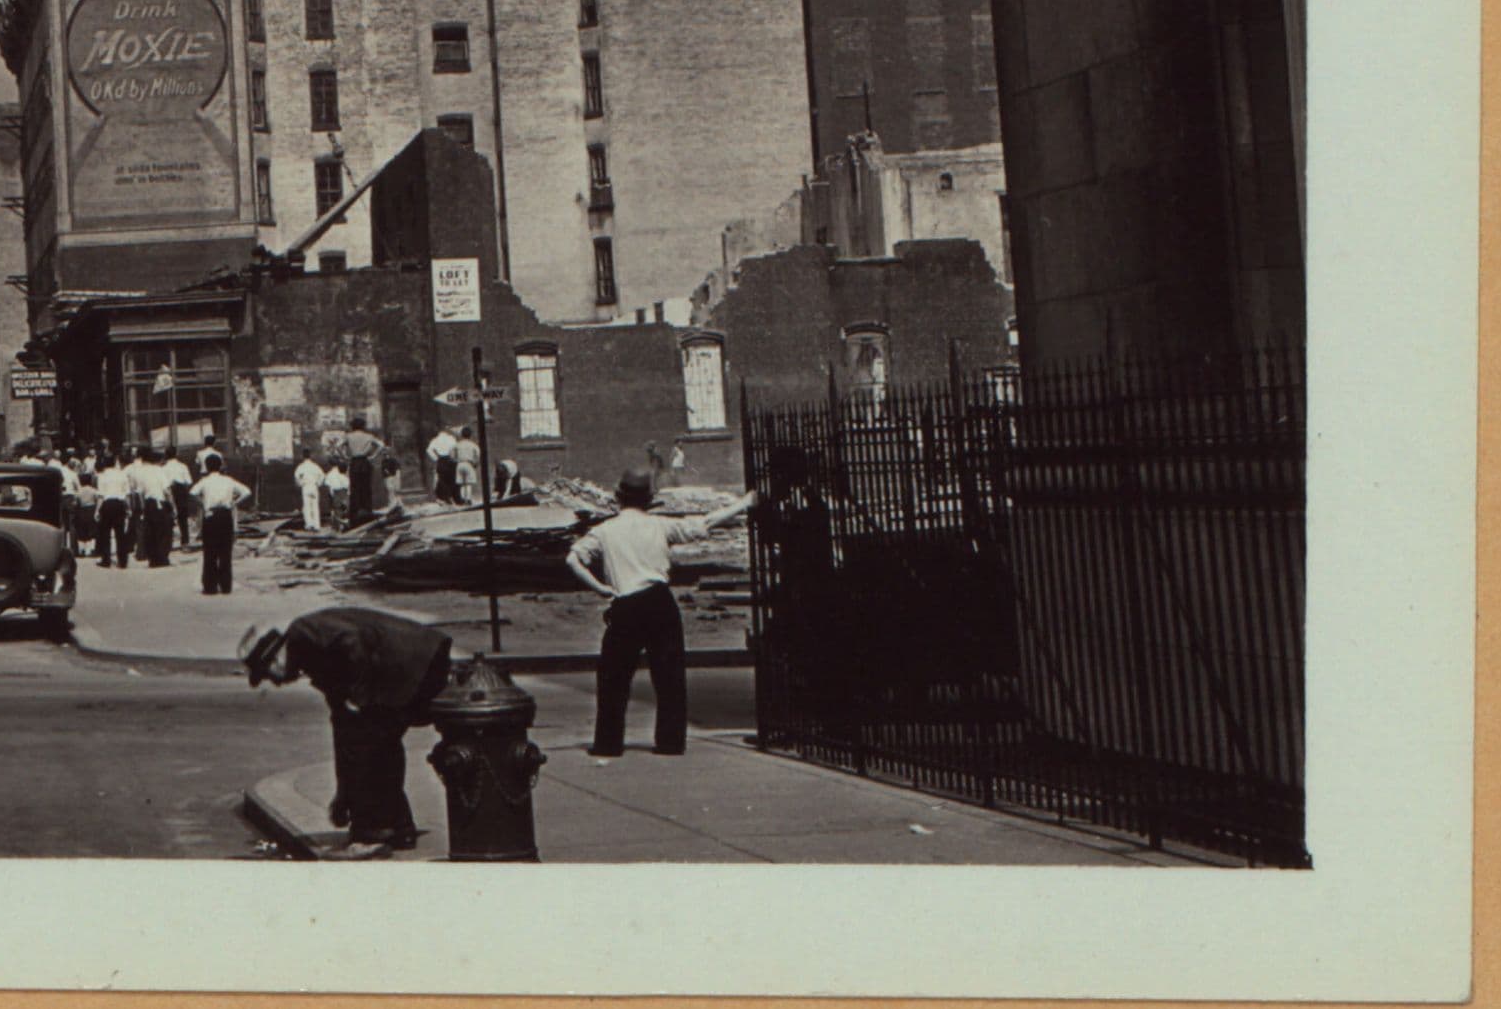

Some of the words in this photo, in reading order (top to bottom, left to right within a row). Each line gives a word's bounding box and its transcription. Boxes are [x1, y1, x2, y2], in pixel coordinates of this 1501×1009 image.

[115, 0, 176, 19] Drink
[80, 25, 215, 72] MOXIE
[129, 79, 148, 102] by
[150, 77, 204, 97] Millions
[440, 270, 469, 280] LOFT
[447, 391, 468, 403] ONE
[482, 389, 504, 399] WAY
